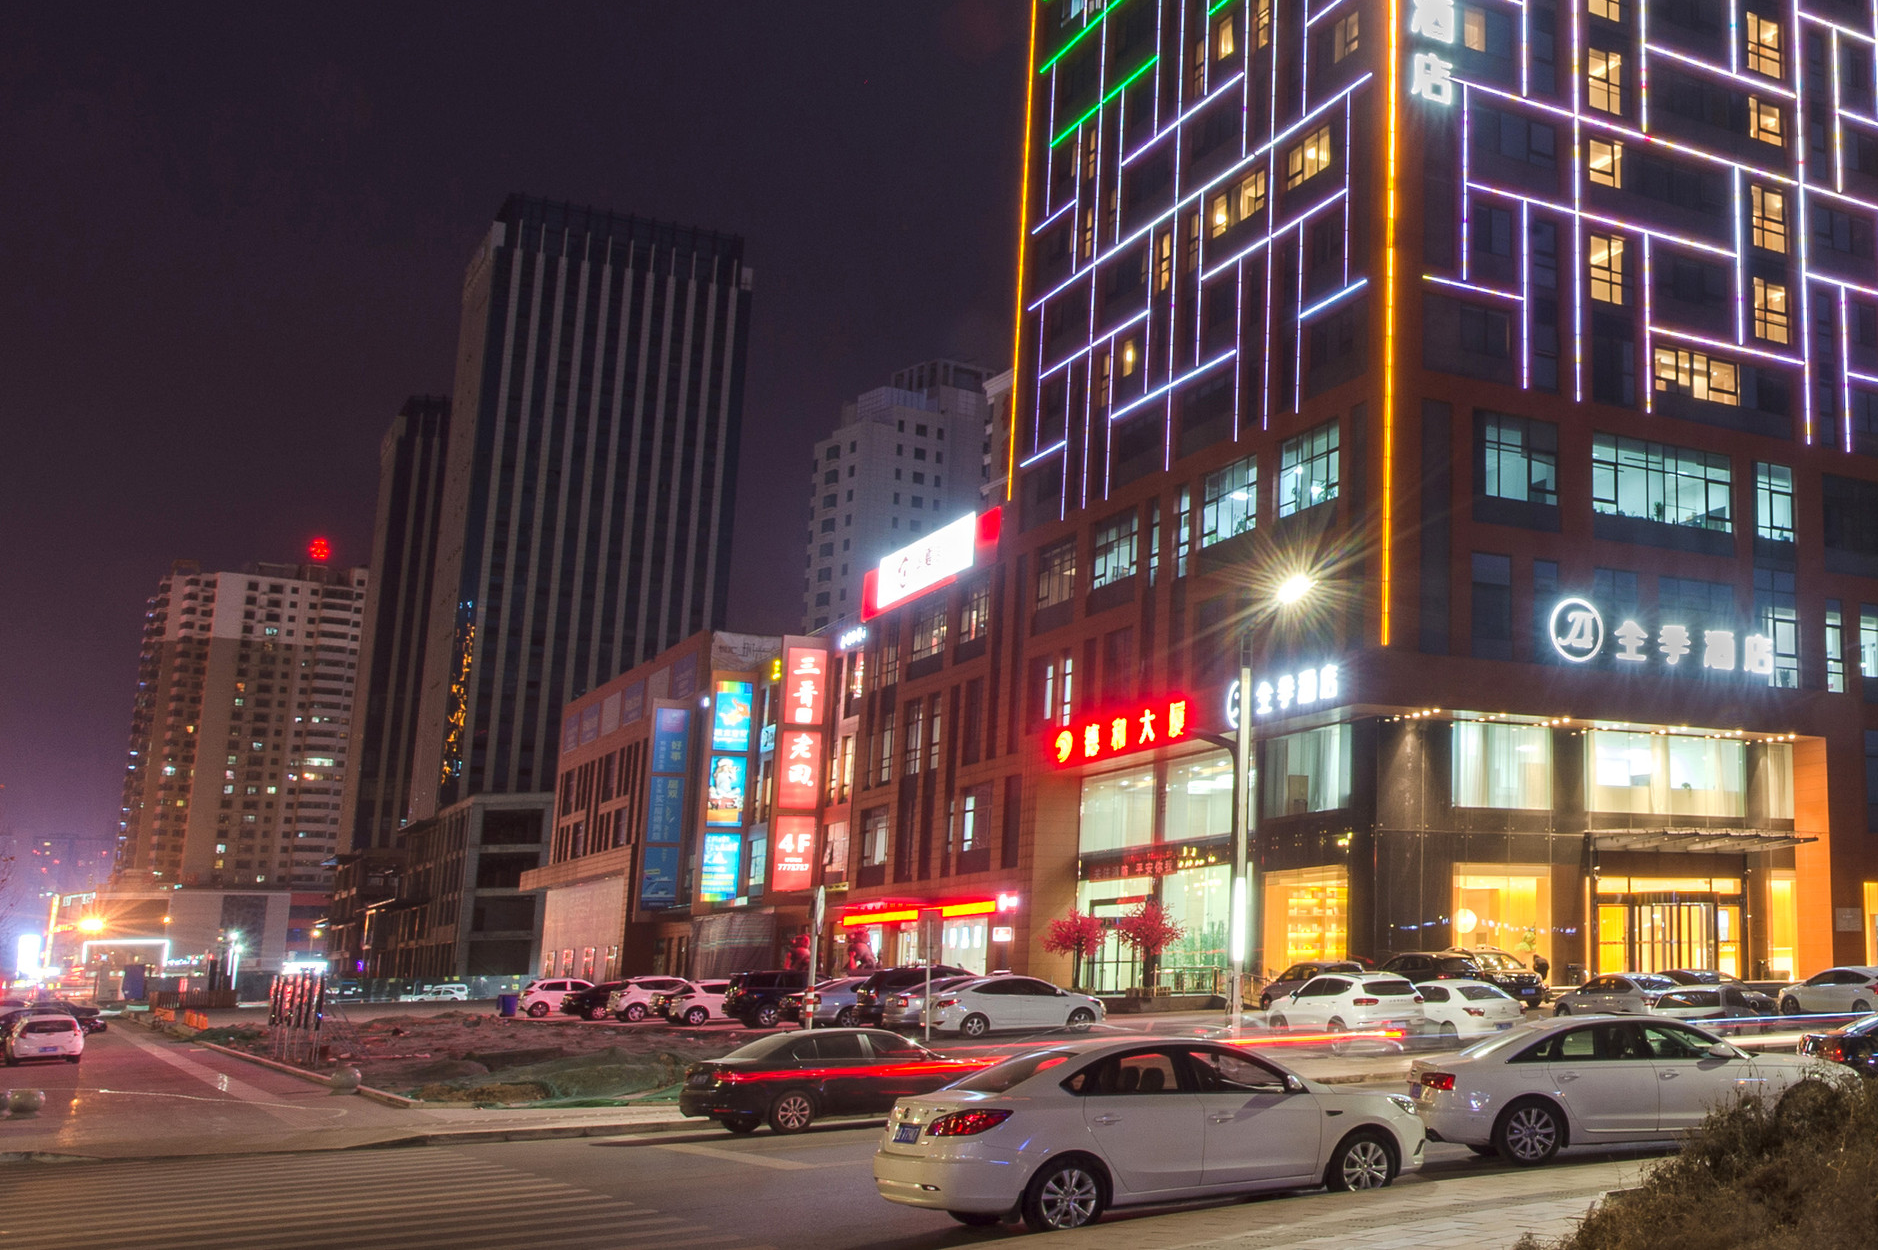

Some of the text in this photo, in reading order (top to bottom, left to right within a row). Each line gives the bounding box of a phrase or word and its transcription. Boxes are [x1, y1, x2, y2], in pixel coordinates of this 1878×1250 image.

[1614, 620, 1774, 674] 全季酒店
[1256, 663, 1338, 715] 全季酒店
[778, 834, 811, 852] 4F
